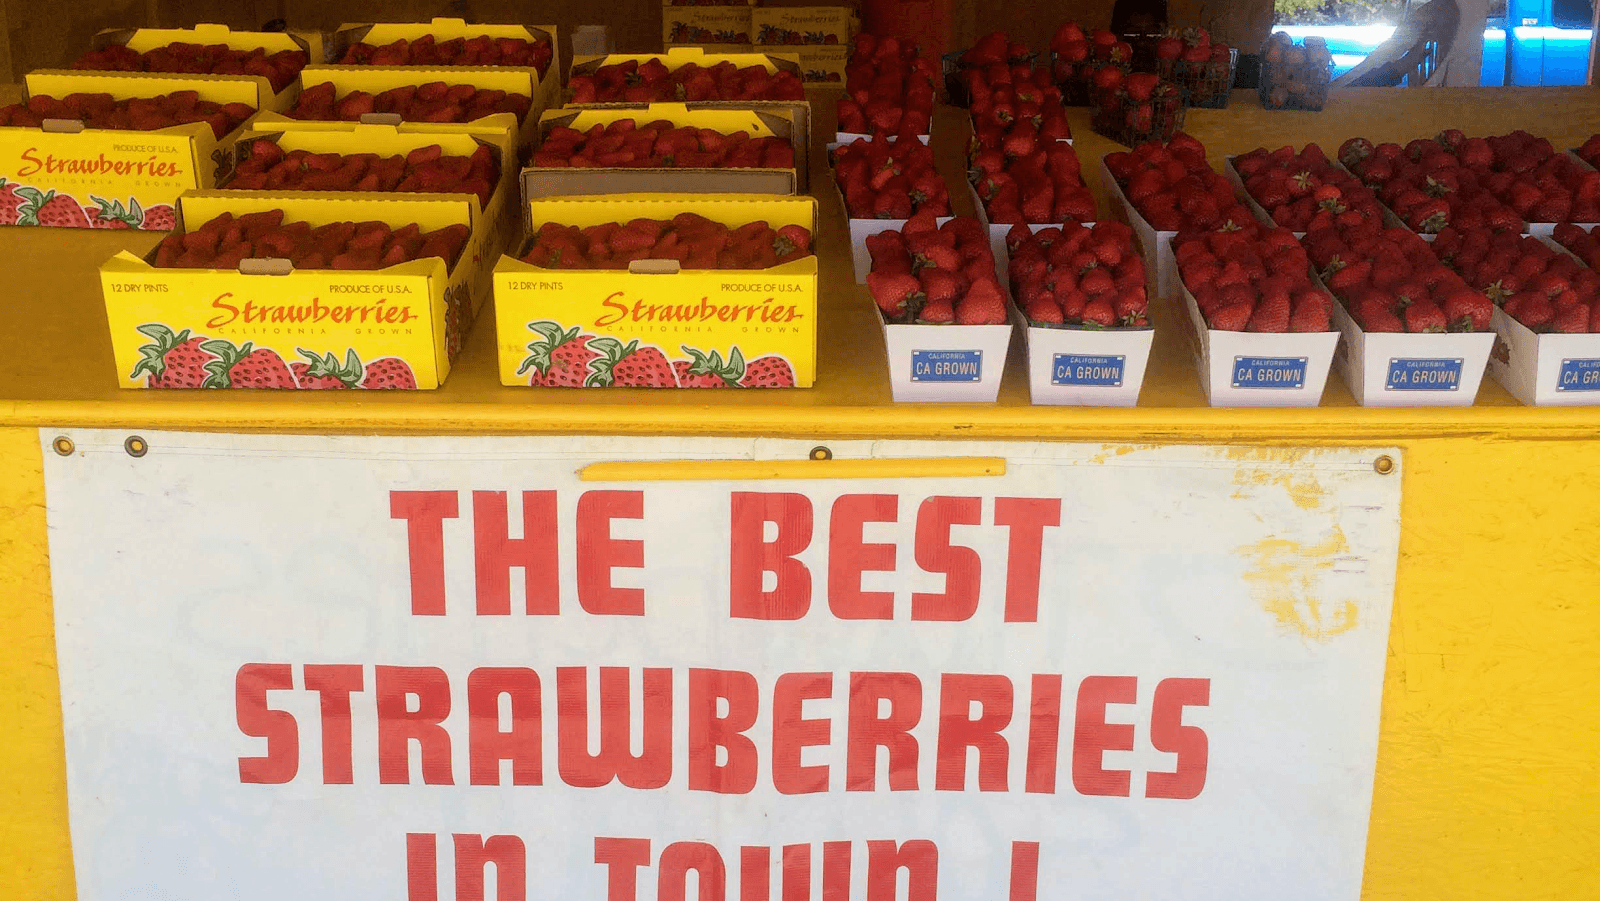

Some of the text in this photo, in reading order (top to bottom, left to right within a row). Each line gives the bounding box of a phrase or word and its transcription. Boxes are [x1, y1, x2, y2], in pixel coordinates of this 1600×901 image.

[113, 144, 146, 153] PRODUCE
[147, 145, 157, 153] OF
[17, 147, 183, 177] Strawberries
[28, 177, 113, 185] CALIFORNIA
[111, 284, 169, 292] 12 DRY PINTS
[329, 285, 413, 294] PRODUCE OF U.S.A.
[507, 281, 564, 290] 12 DRY PINTS
[721, 283, 804, 293] PRODUCE OF U.S.A.
[206, 292, 418, 329] Strawberries
[594, 291, 804, 327] Strawberries
[1070, 356, 1108, 364] CALIFORNIA
[916, 362, 978, 375] CA GROWN
[1057, 365, 1120, 380] CA GROWN
[1237, 368, 1301, 382] CA GROWN
[1392, 370, 1457, 384] CA GROWN
[1563, 371, 1578, 384] CA
[390, 490, 1062, 623] THE BEST
[236, 663, 1210, 800] STRAWBERRIES
[406, 833, 526, 901] IN
